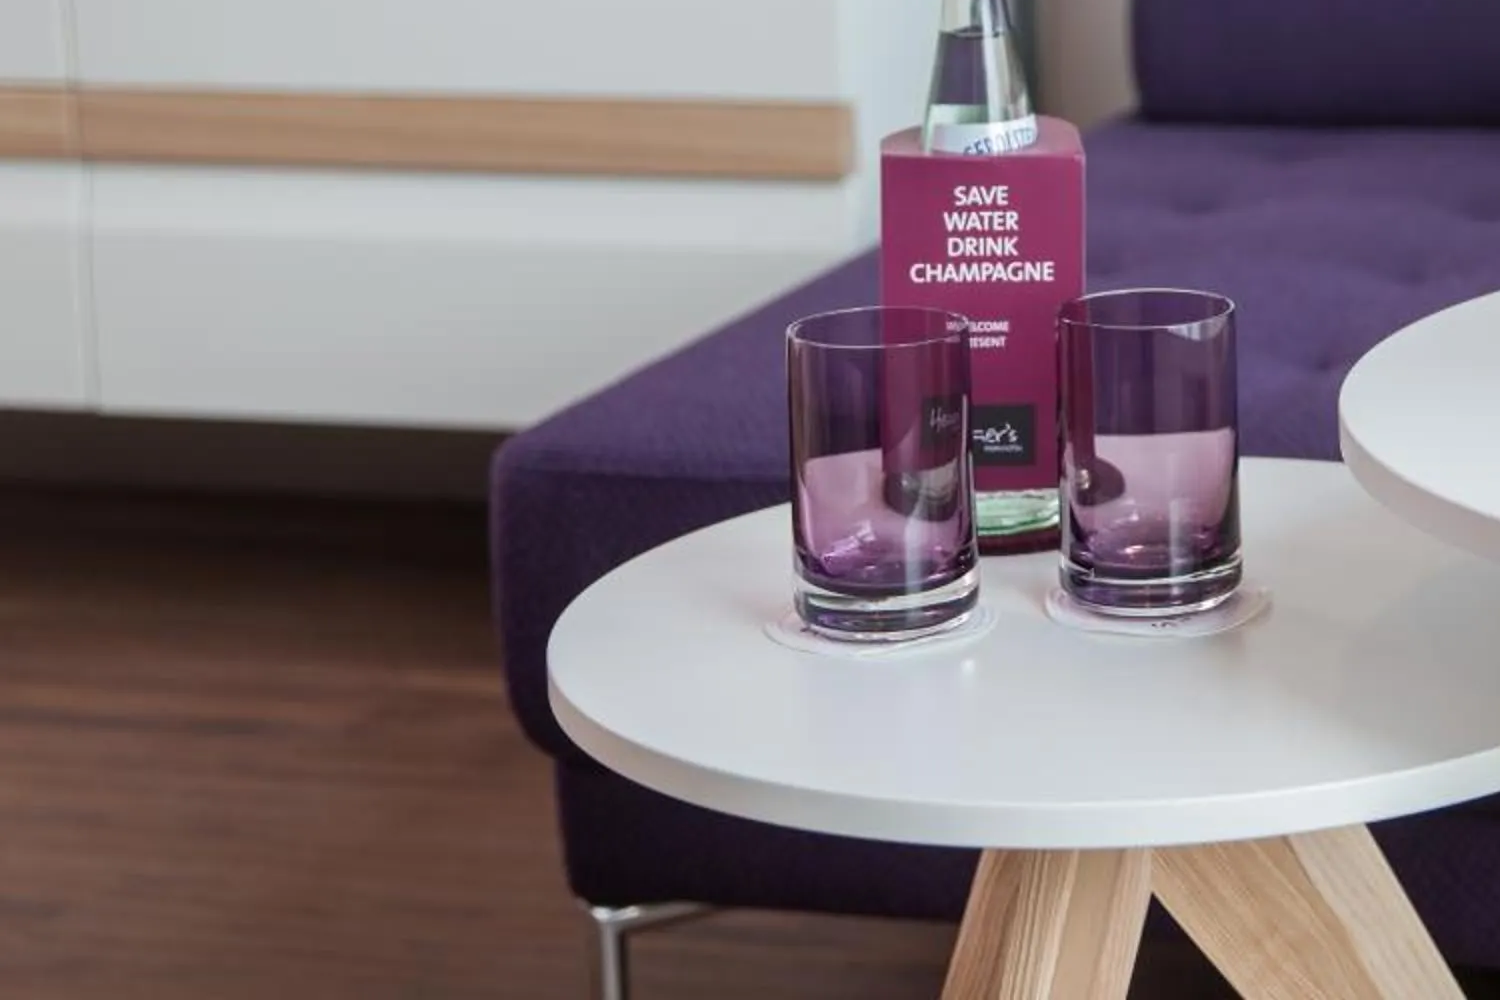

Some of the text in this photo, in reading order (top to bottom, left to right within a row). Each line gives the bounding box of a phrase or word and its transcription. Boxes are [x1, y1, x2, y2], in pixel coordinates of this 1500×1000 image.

[953, 185, 1009, 206] SAVE
[943, 210, 1019, 232] WATER
[947, 236, 1019, 257] DRINK
[909, 261, 1056, 283] CHAMPAGNE
